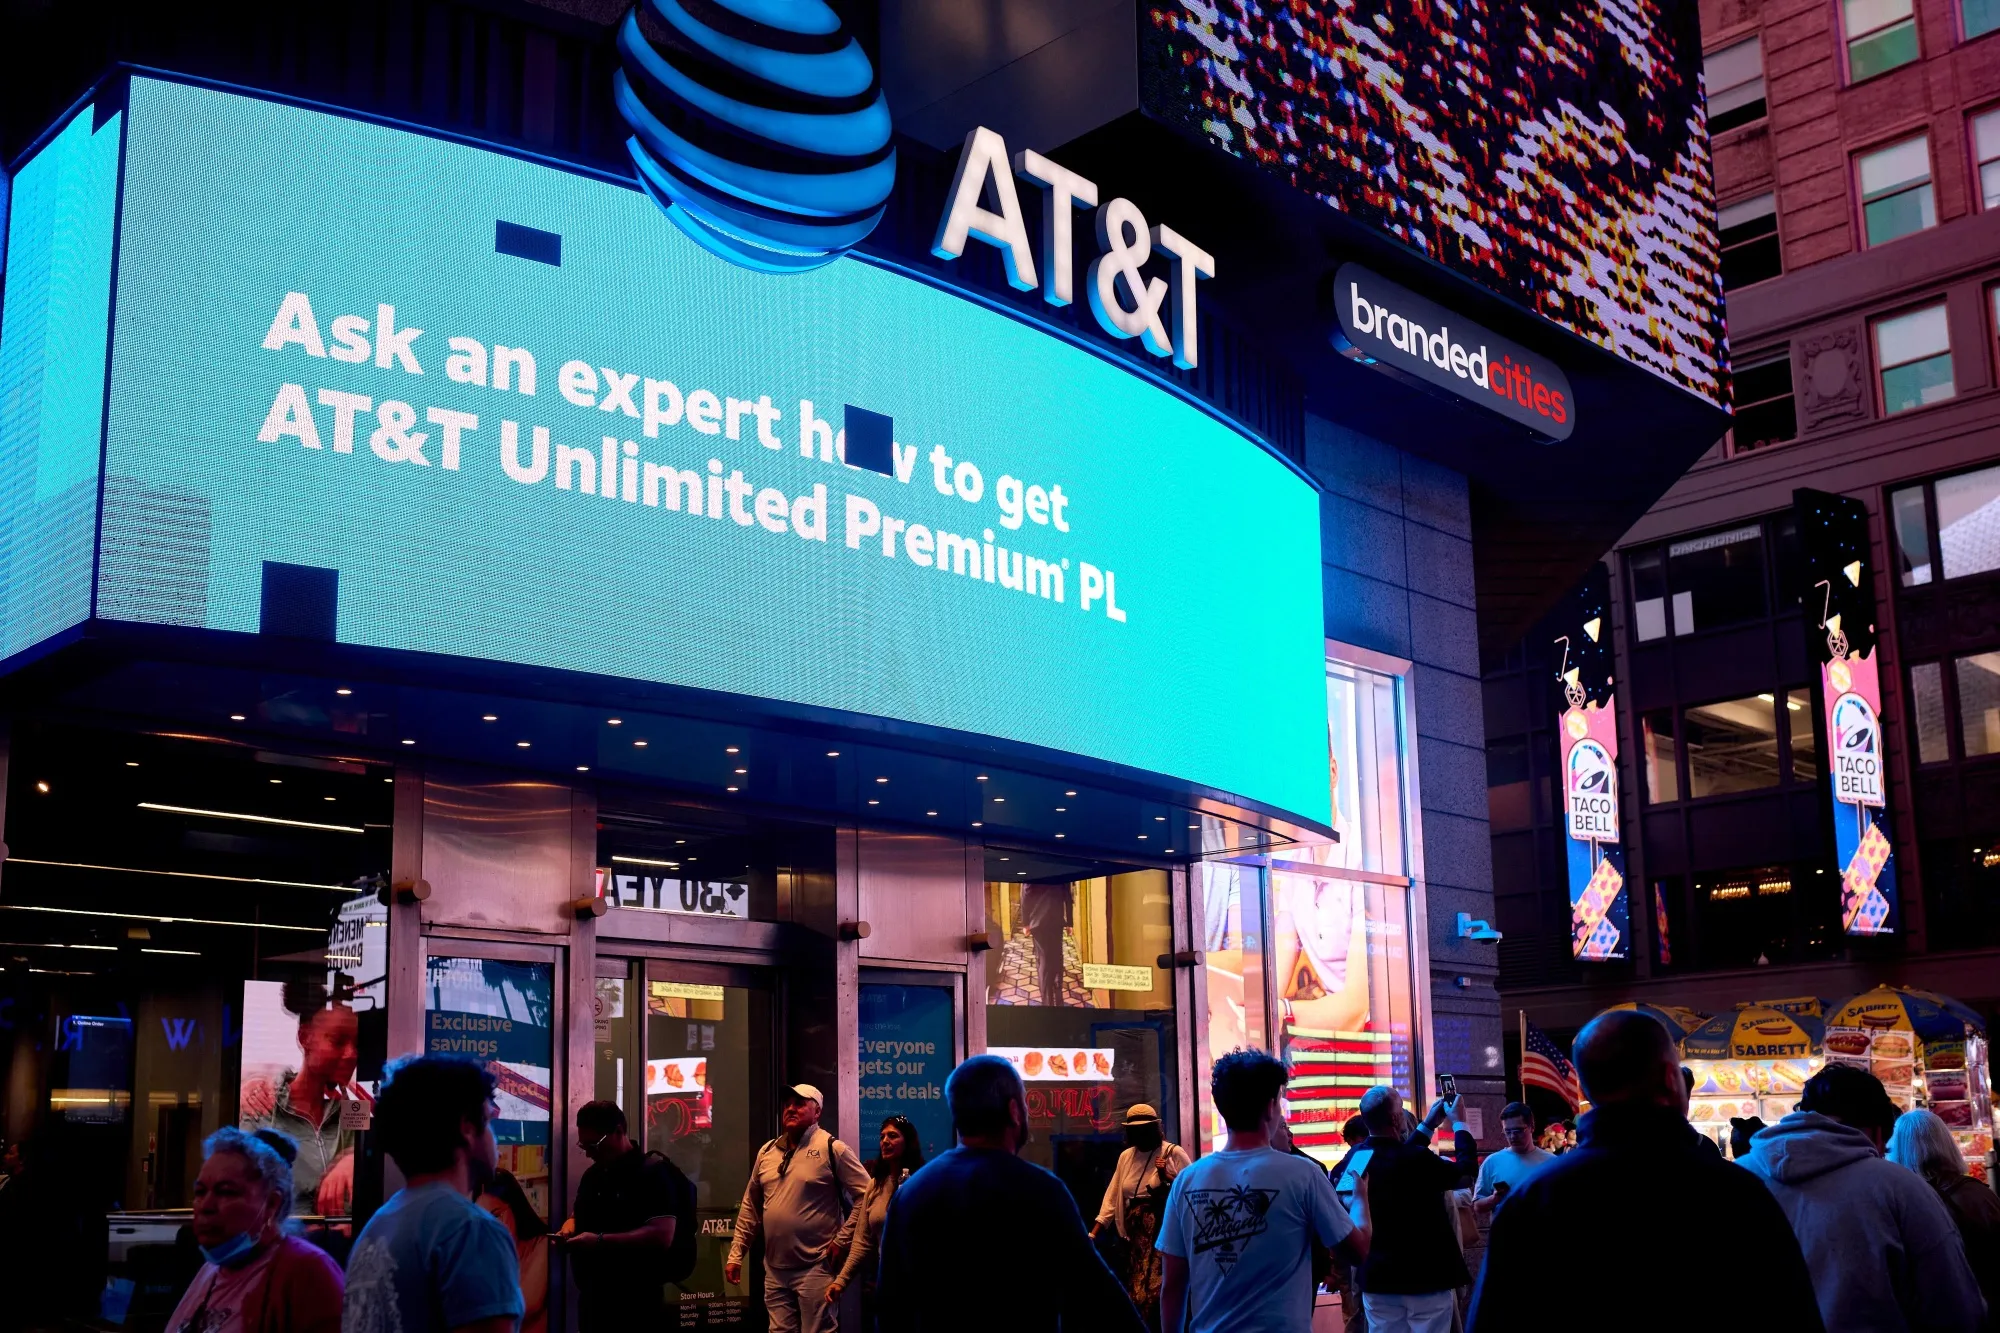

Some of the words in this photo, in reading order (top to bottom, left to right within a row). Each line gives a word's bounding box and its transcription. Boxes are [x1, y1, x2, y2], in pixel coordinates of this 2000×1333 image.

[930, 125, 1215, 370] AT&T
[1350, 281, 1567, 425] brandedcities
[261, 291, 425, 375] Ask
[446, 335, 536, 396] an
[557, 358, 782, 451] expert
[928, 443, 984, 503] to
[996, 473, 1070, 533] get
[257, 382, 479, 471] AT&T
[500, 420, 827, 543] Unlimited
[1080, 561, 1127, 623] PL
[1836, 755, 1877, 777] TACO
[1840, 776, 1878, 796] BELL
[1572, 796, 1611, 814] TACO
[1575, 815, 1612, 833] BELL
[1848, 1004, 1898, 1017] SABRETT
[431, 1013, 512, 1032] Exclusive
[1741, 1018, 1786, 1030] SABRETT
[430, 1035, 498, 1057] savings
[858, 1036, 935, 1058] Everyone
[1736, 1044, 1807, 1056] SABRETT
[896, 1062, 925, 1076] our
[896, 1082, 940, 1100] deals
[701, 1219, 732, 1234] AT&T
